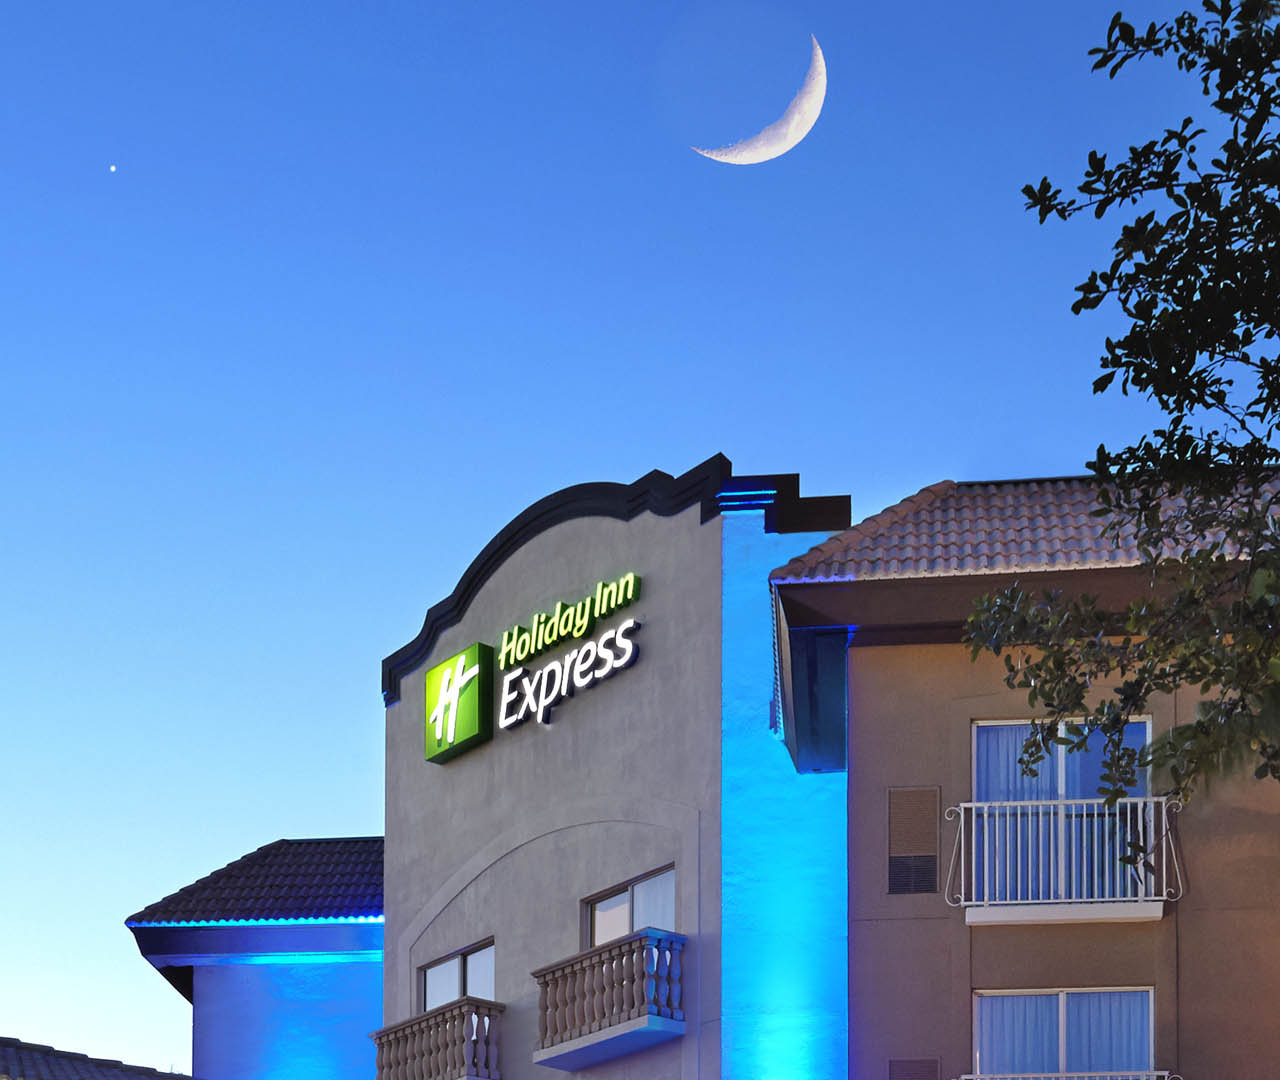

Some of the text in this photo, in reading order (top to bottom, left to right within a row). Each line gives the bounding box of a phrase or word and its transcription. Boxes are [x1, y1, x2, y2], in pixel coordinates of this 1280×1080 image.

[498, 572, 635, 670] Holiday Inn
[498, 619, 636, 729] Express
